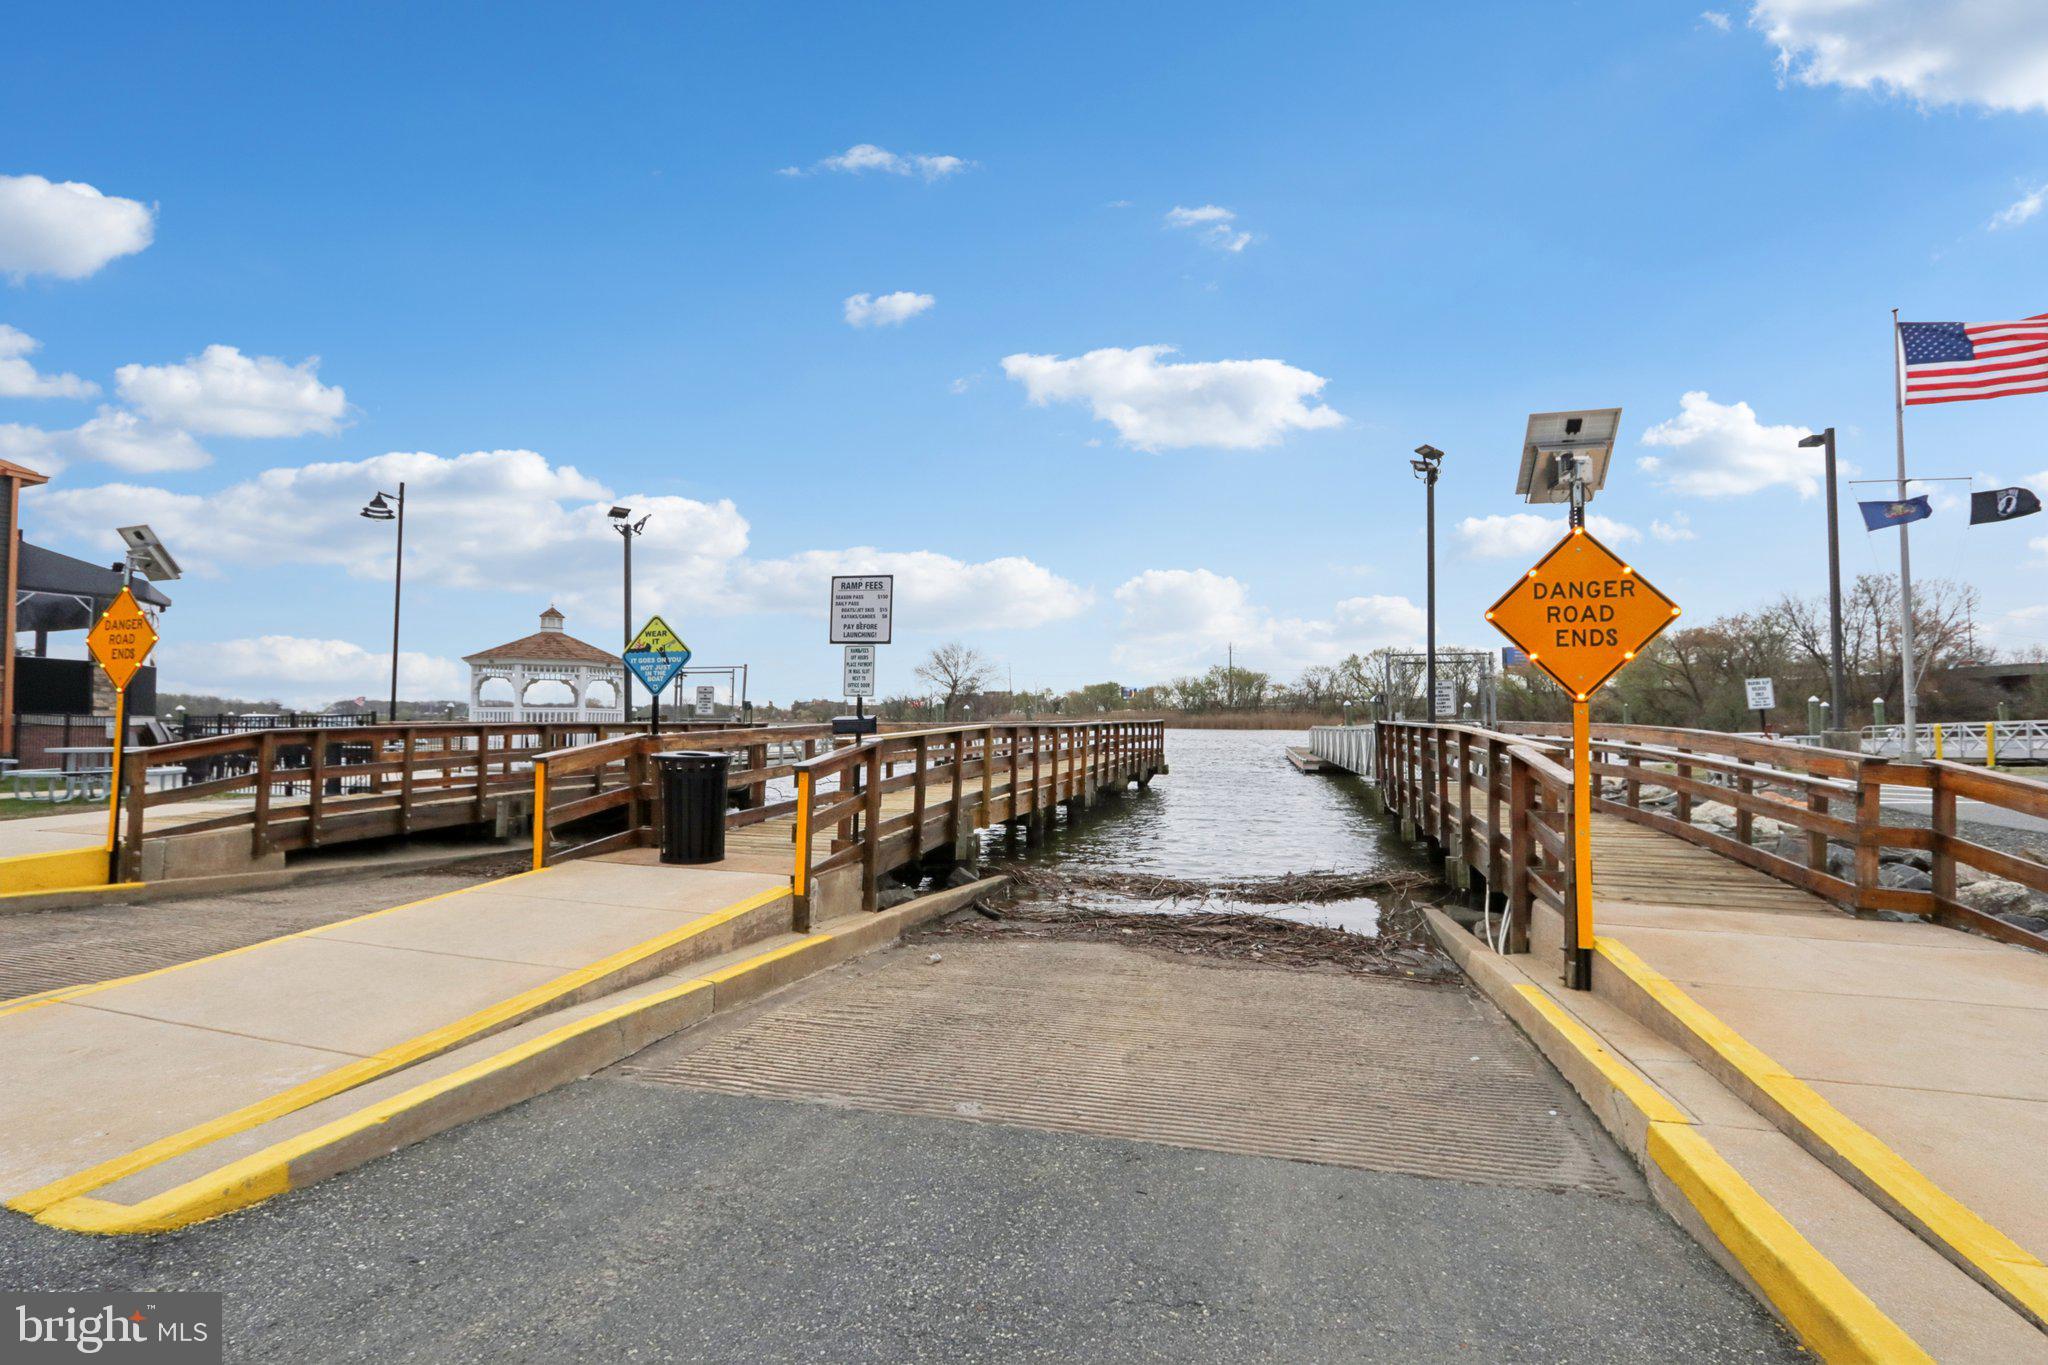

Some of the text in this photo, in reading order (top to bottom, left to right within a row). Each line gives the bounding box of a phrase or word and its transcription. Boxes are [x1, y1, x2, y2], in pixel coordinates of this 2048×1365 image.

[841, 581, 884, 590] RAMP FEES
[1533, 579, 1635, 600] DANGER
[1546, 604, 1615, 624] ROAD
[105, 619, 143, 630] DANGER
[108, 633, 136, 645] ROAD
[1555, 628, 1619, 648] ENDS
[111, 648, 136, 660] ENDS
